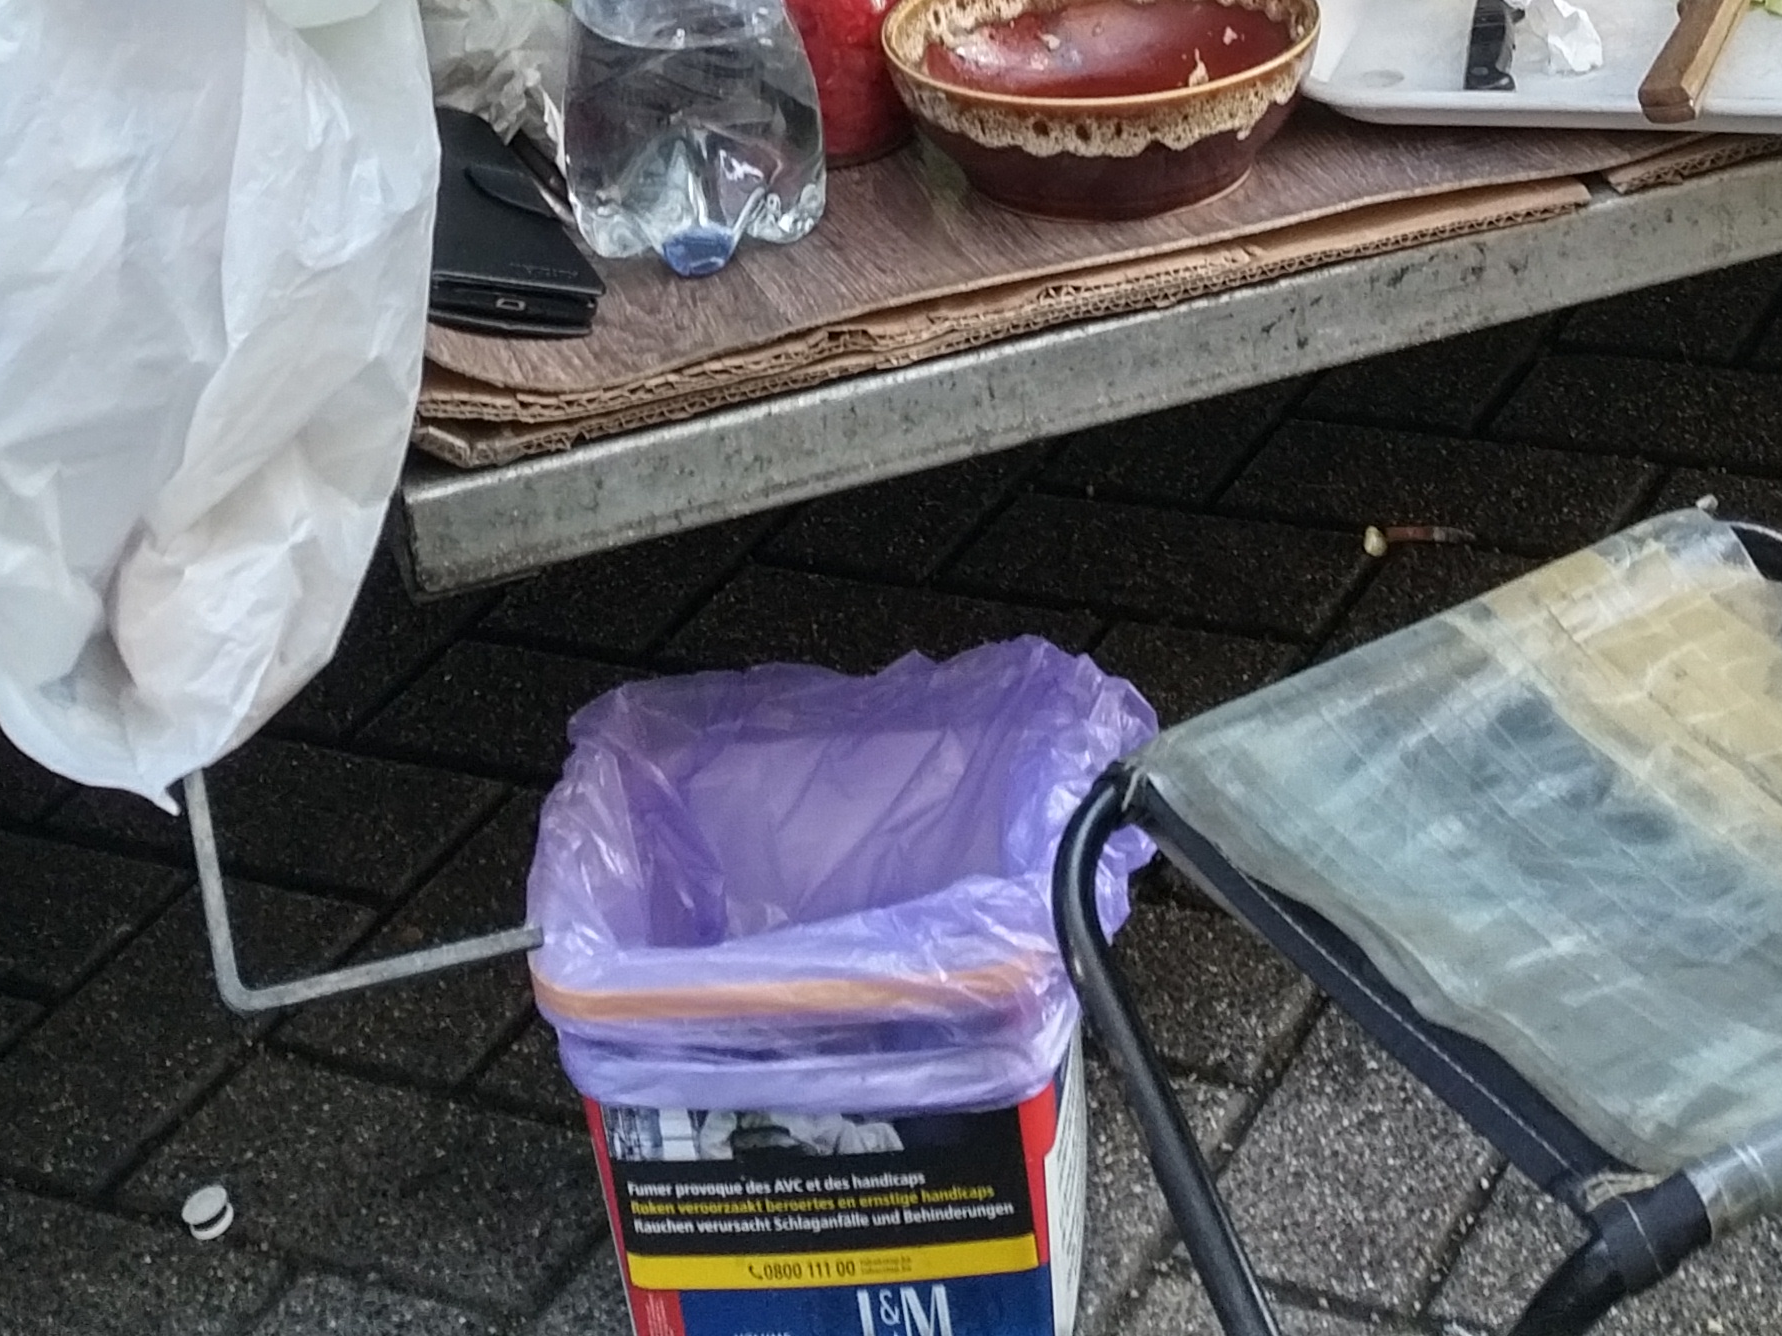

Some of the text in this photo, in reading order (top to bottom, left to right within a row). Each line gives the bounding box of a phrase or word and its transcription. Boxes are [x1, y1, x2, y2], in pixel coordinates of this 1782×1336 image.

[627, 1172, 926, 1199] Fumer provoque des AVC et des handicaps
[631, 1184, 995, 1216] Roken veroorzaakt beroertes en ernstige handicaps
[633, 1201, 1015, 1234] Rauchen verursacht Schlaganfälle und Behinderungen
[763, 1262, 802, 1280] 0800
[808, 1261, 831, 1278] 111
[836, 1259, 856, 1276] 00
